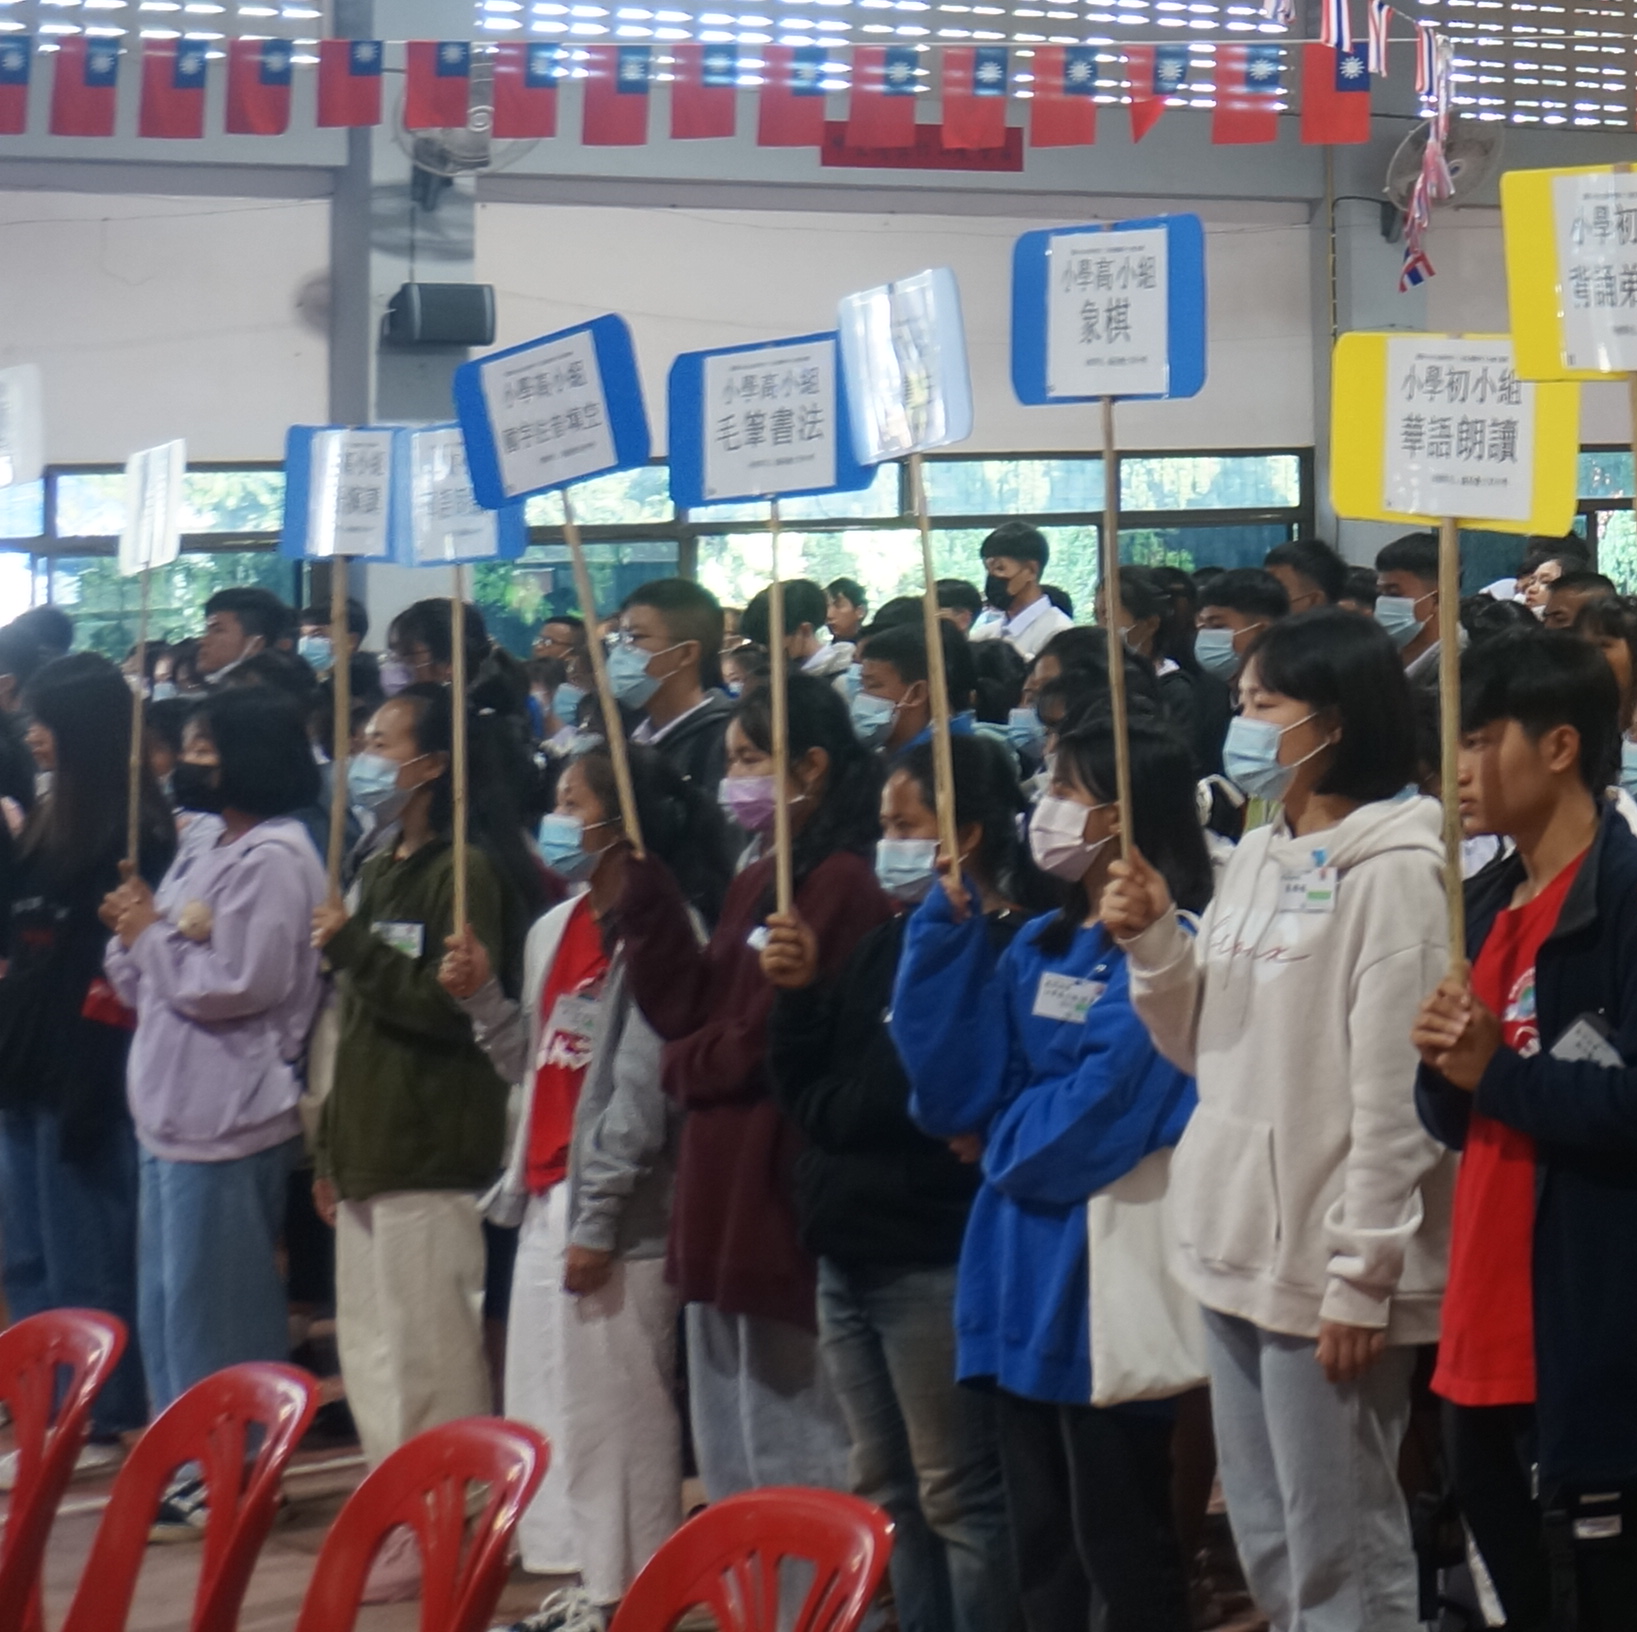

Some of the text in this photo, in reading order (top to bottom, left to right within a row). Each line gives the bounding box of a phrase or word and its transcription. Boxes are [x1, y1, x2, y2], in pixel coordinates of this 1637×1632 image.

[1062, 255, 1157, 293] 小學高小組
[1079, 297, 1133, 345] 象棋
[1402, 363, 1523, 405] 小學初小組
[715, 402, 825, 451] 毛筆書法
[1400, 412, 1519, 464] 華語朗讀
